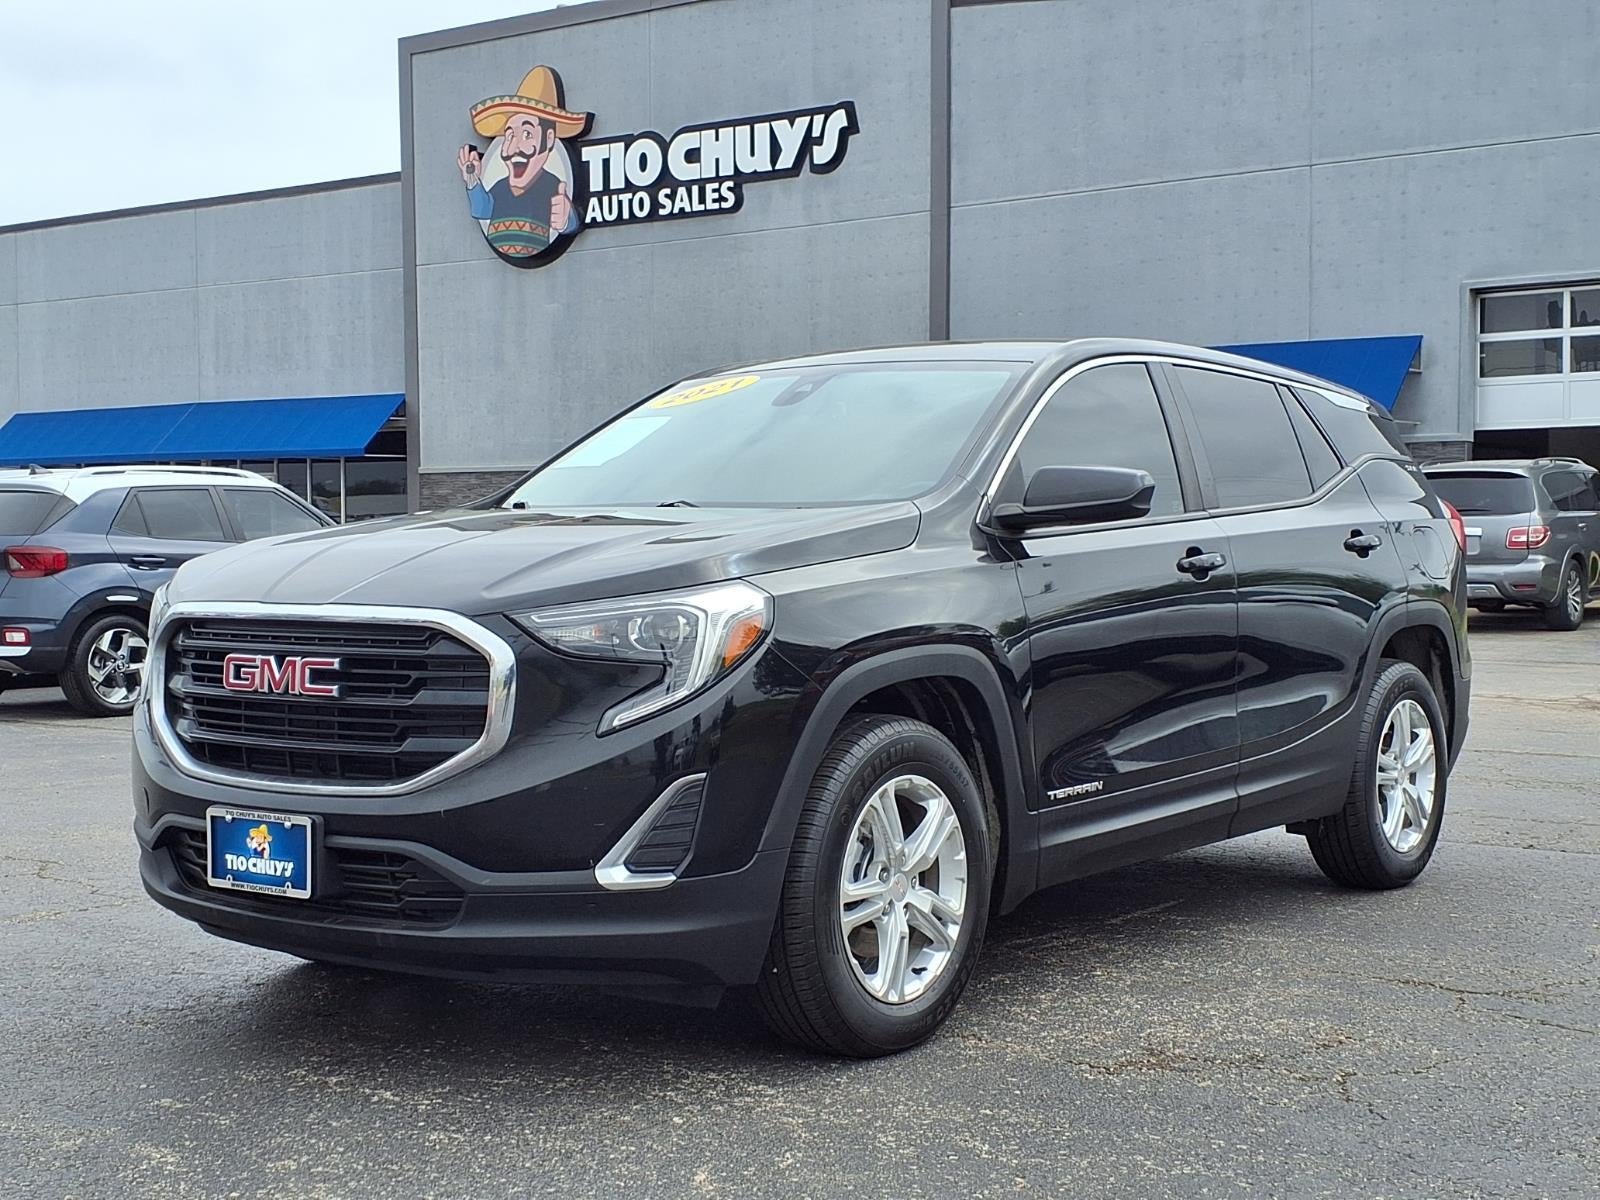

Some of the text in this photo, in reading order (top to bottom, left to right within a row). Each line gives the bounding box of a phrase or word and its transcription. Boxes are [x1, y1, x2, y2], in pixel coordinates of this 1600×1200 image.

[581, 108, 849, 192] TIO CHUY'S
[584, 180, 736, 224] AUTO SALES
[223, 653, 341, 698] GMC
[1047, 780, 1104, 801] TERRAIN
[257, 813, 272, 821] AUTO
[273, 815, 292, 823] SALES
[225, 853, 295, 878] TIO CHUY'S
